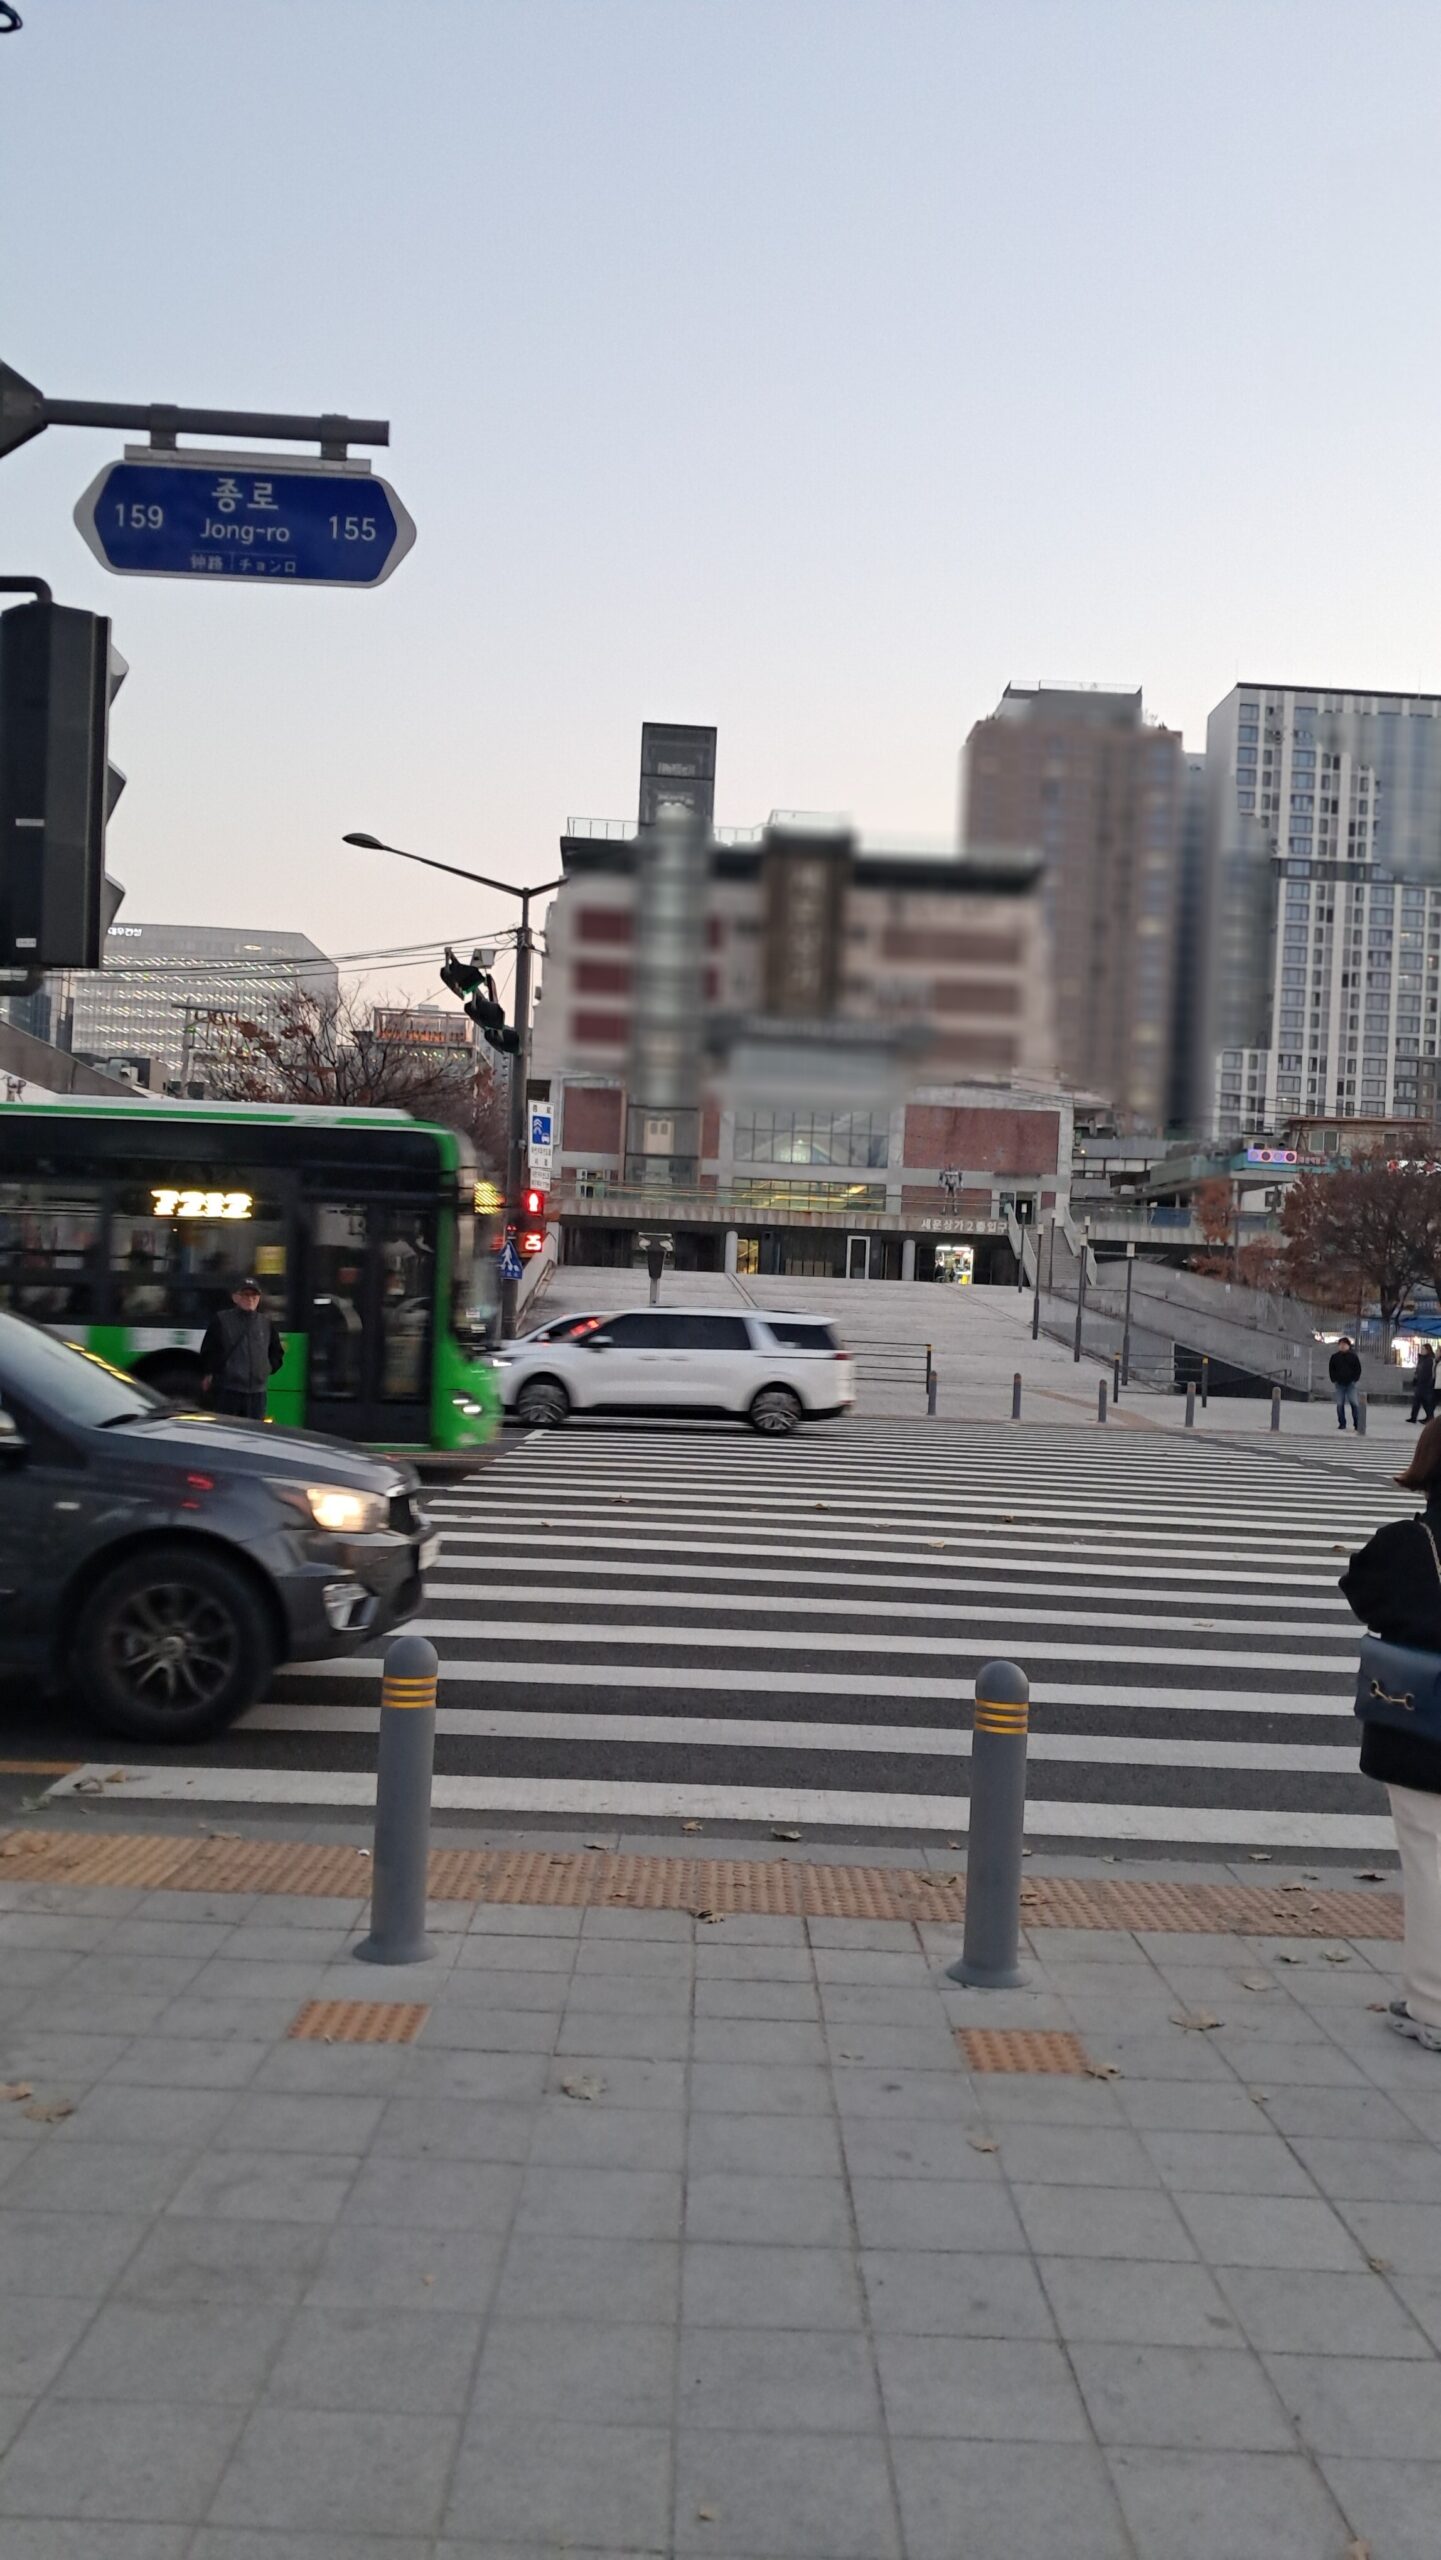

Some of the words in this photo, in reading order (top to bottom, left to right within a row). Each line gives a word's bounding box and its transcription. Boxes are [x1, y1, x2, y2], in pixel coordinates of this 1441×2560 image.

[211, 477, 279, 513] 종로
[115, 503, 164, 530] 159
[328, 514, 377, 542] 155
[200, 517, 290, 545] Jong-ro
